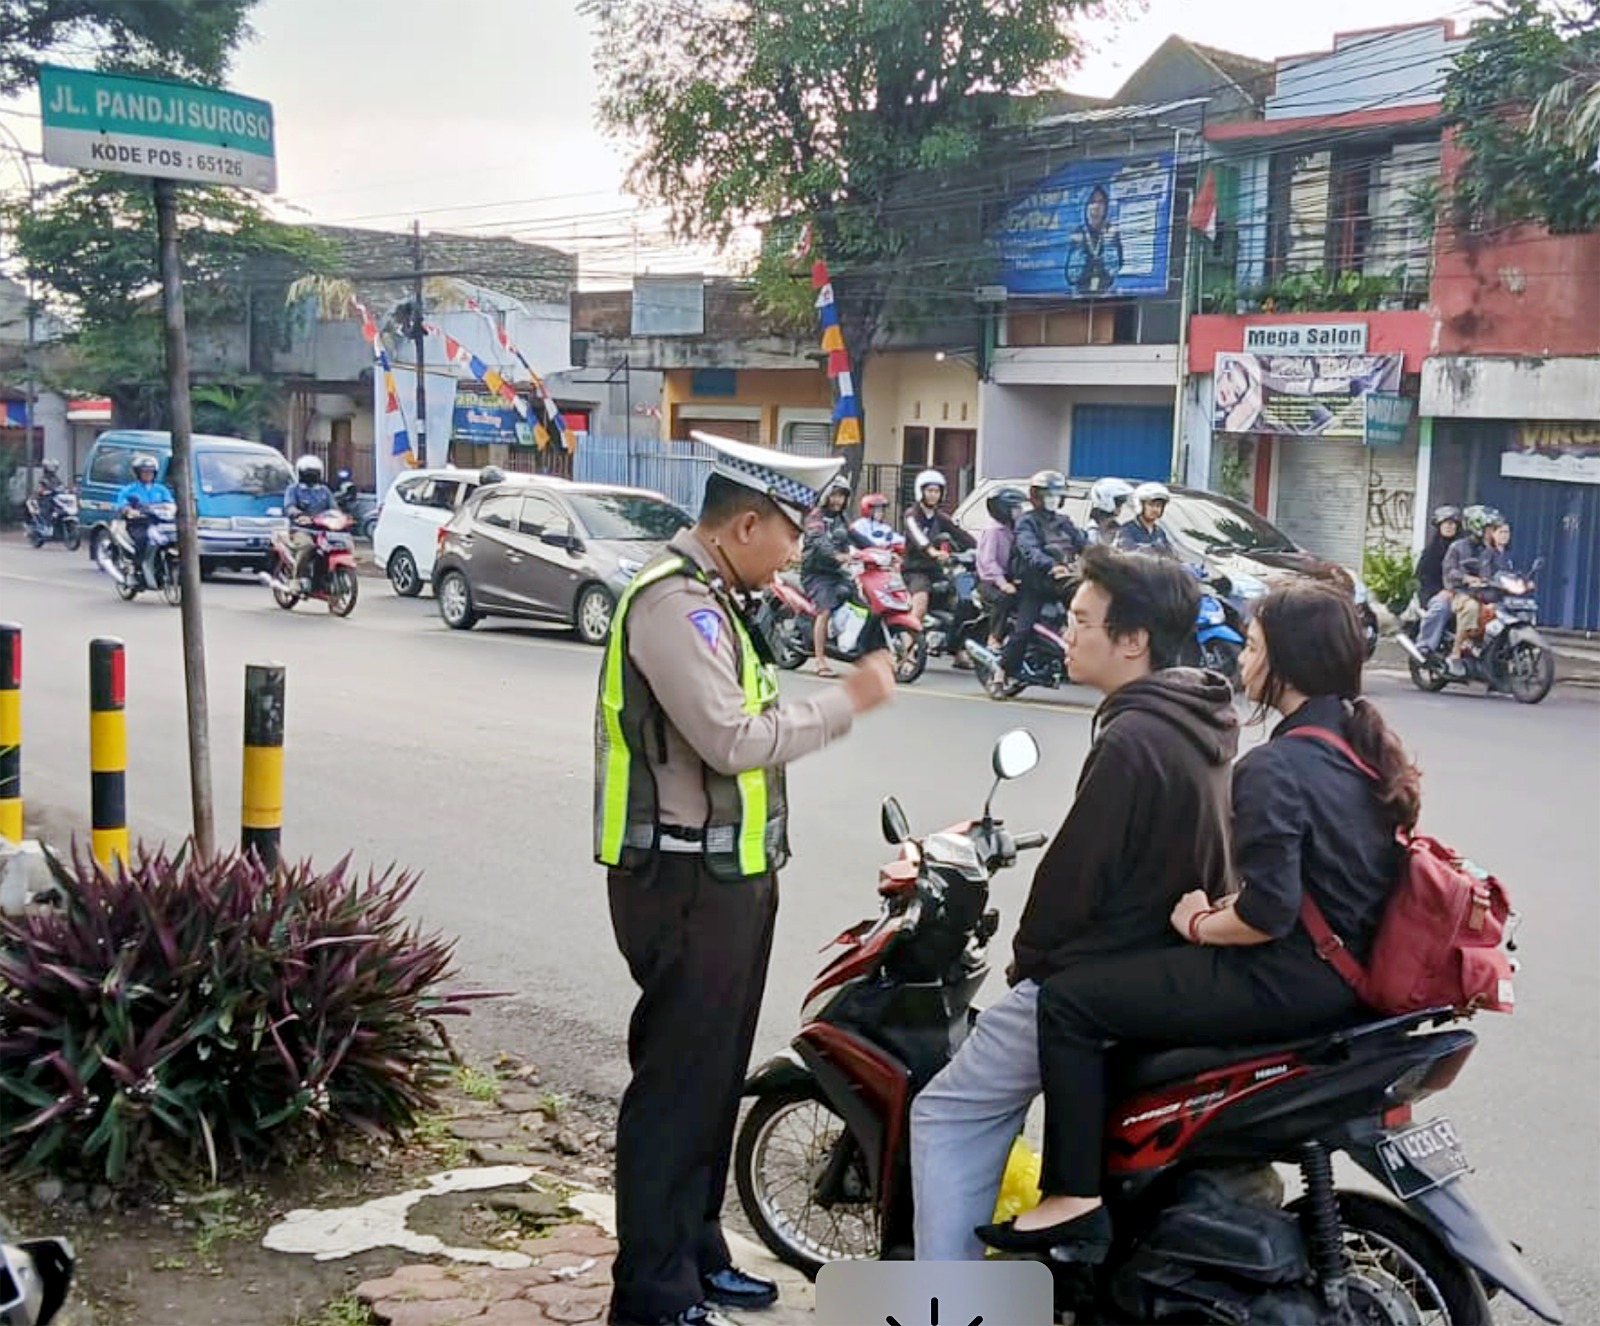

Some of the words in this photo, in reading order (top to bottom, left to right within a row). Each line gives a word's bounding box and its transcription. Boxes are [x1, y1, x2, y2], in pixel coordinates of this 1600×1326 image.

[49, 85, 87, 115] JL.
[96, 89, 184, 125] PANDJI
[187, 103, 270, 141] SUROSO
[91, 142, 142, 164] KODE
[147, 149, 182, 168] POS
[196, 154, 243, 177] 65126
[1248, 329, 1299, 347] Mega
[1306, 327, 1361, 345] Salon
[1382, 1142, 1405, 1171] N
